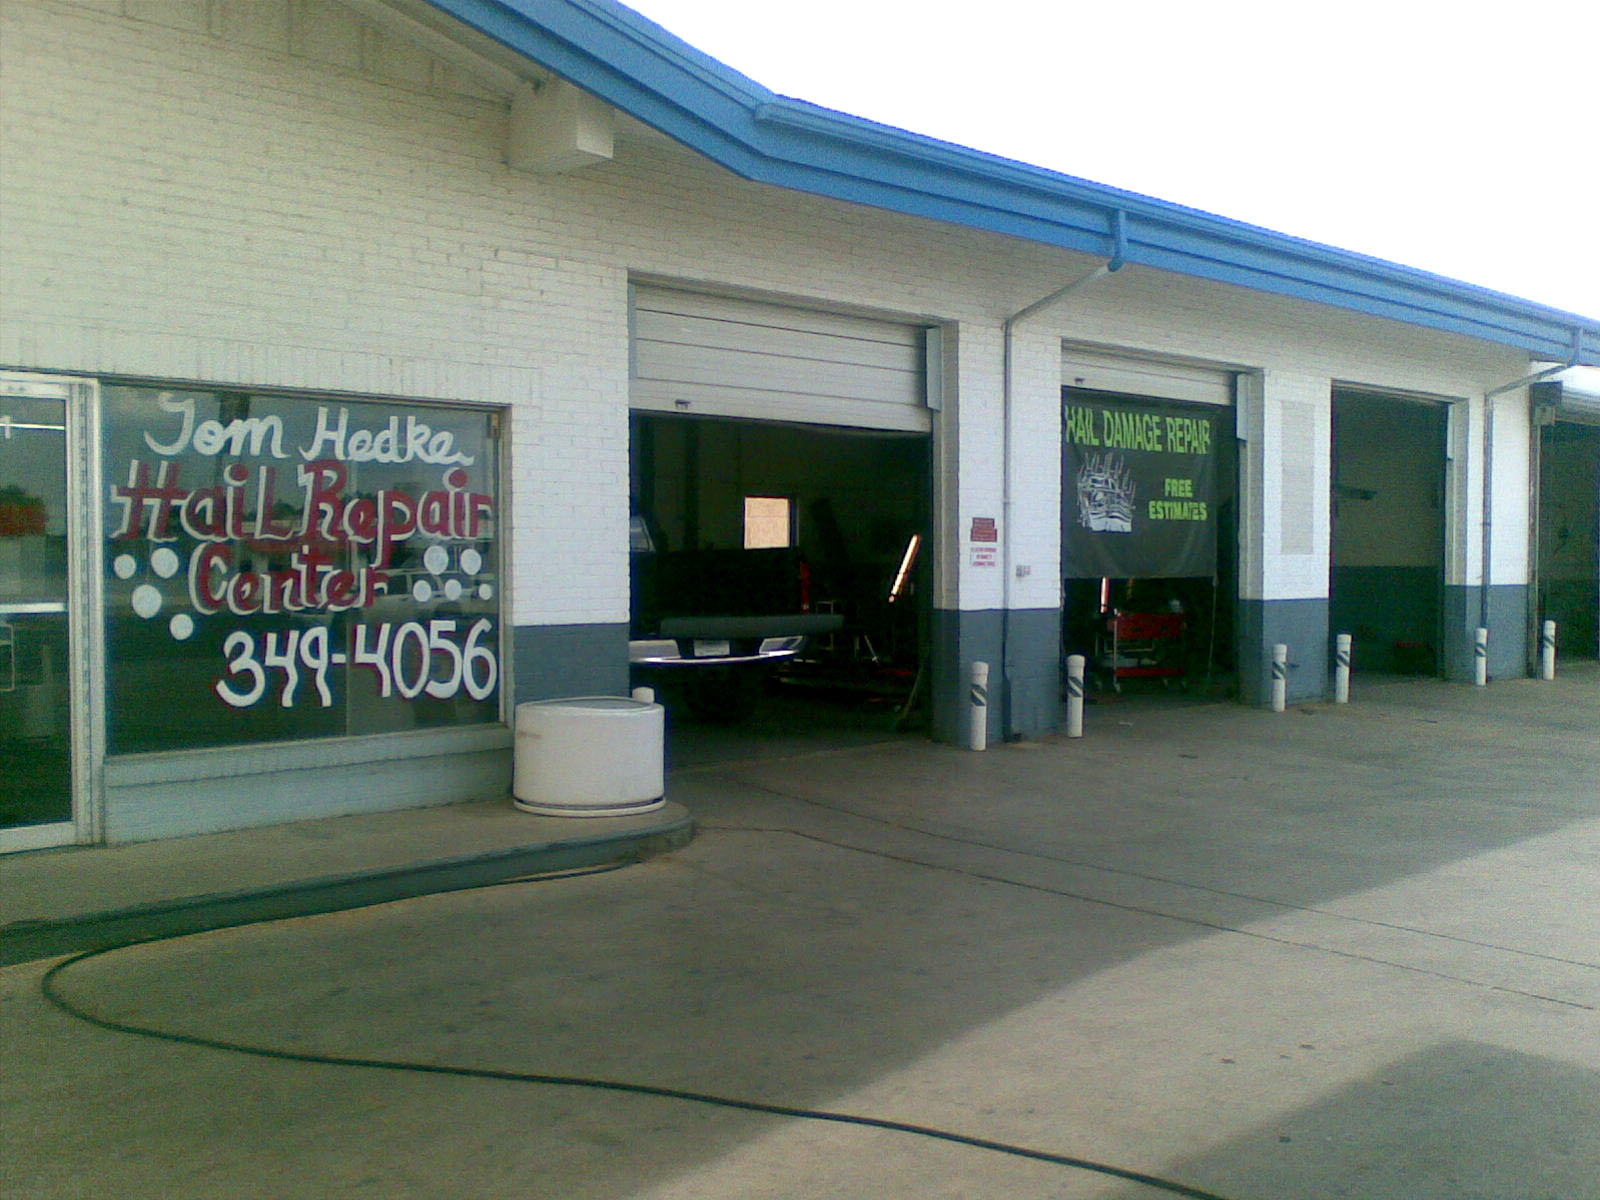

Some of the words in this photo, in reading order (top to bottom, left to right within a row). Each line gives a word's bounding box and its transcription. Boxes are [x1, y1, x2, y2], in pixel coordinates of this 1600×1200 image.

[144, 391, 291, 459] Tom
[299, 406, 475, 467] Hedke
[1065, 405, 1099, 446] HAIL
[1103, 409, 1163, 452] DAMAGE
[1166, 416, 1211, 454] REPAIR
[297, 459, 493, 569] Repair
[1148, 501, 1208, 521] ESTIMATES
[1164, 478, 1193, 498] FREE
[188, 541, 389, 616] Center
[214, 618, 498, 708] 349-4056
